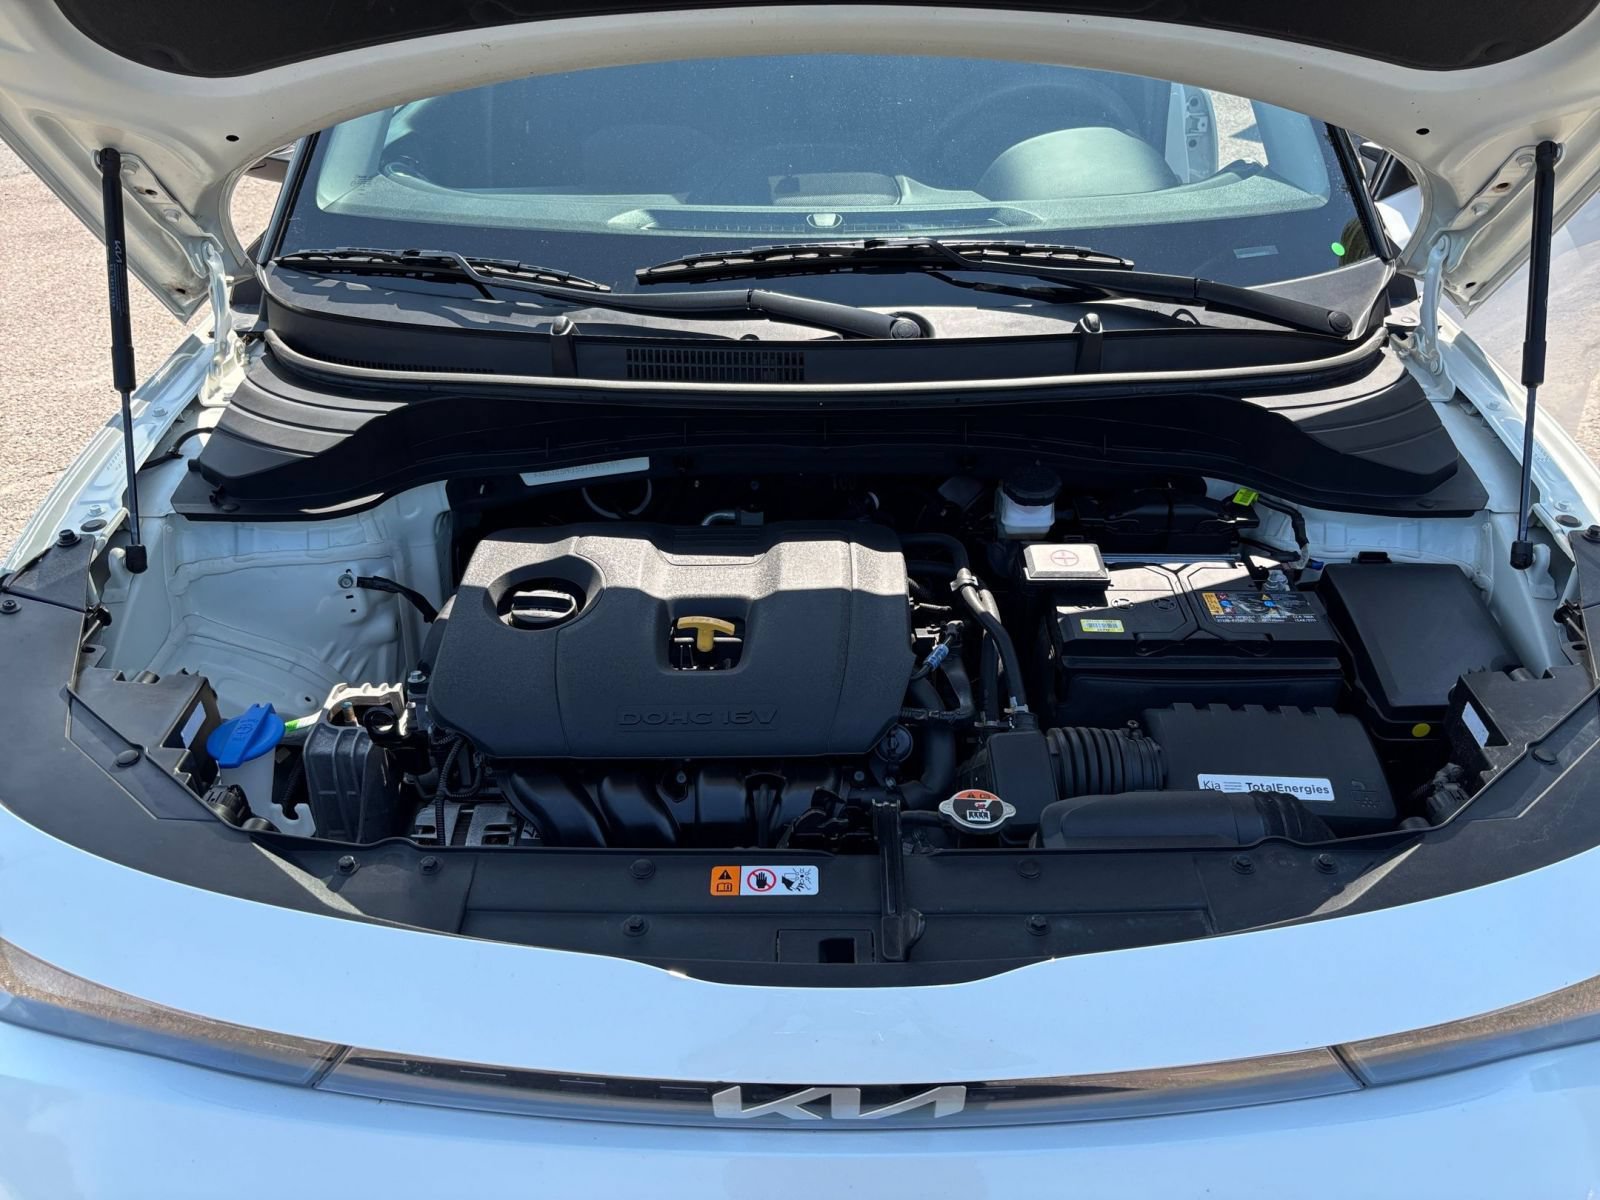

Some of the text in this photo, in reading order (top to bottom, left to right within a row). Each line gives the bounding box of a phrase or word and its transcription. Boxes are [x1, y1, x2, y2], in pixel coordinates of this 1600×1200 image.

[618, 709, 778, 726] DOHC 16V
[1203, 780, 1330, 795] Kia TotalEnergies
[712, 1085, 967, 1119] KIA
